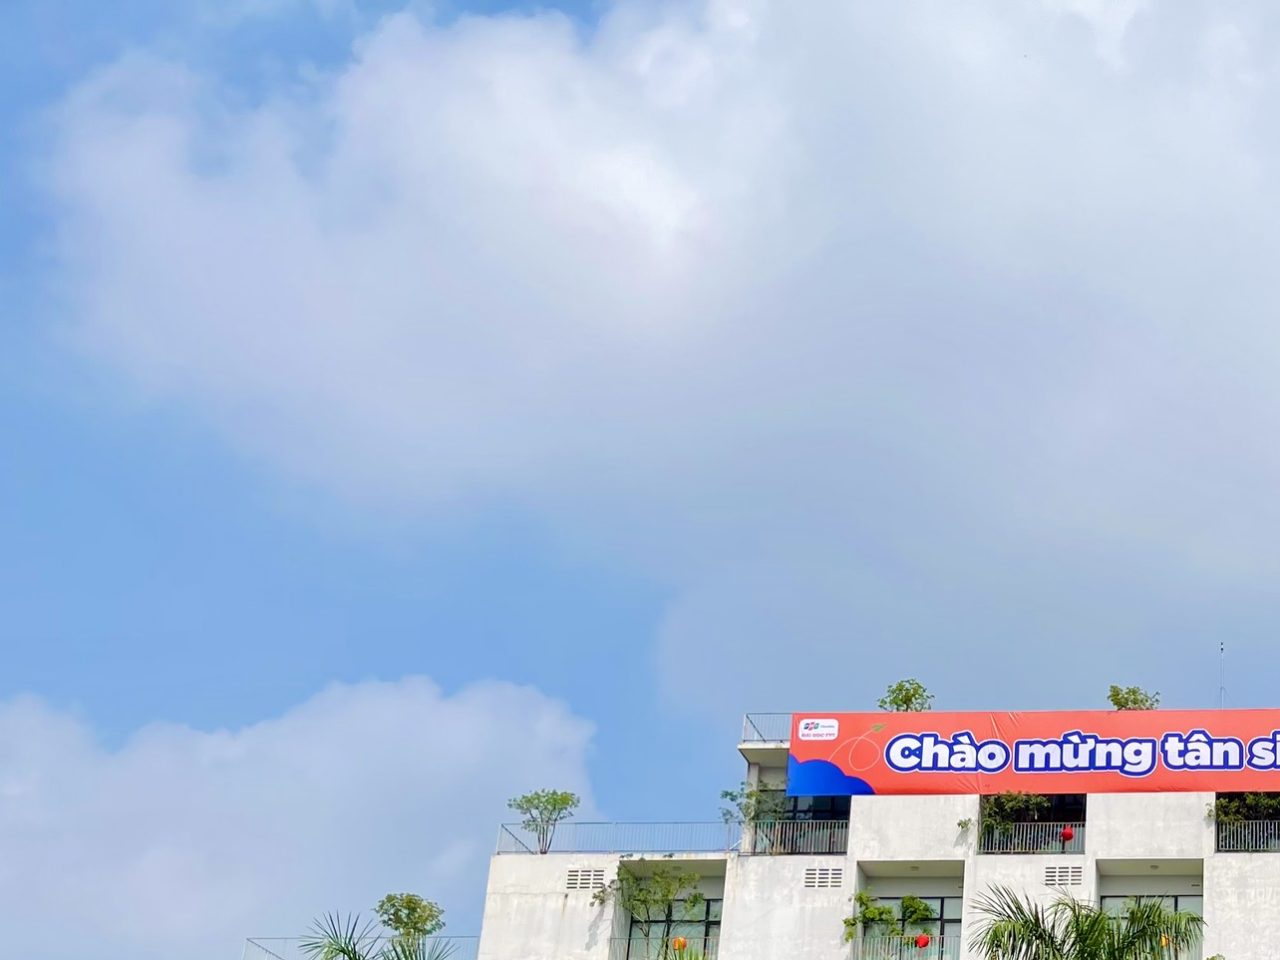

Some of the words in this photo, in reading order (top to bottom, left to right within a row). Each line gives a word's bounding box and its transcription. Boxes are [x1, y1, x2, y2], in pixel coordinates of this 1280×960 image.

[886, 732, 1009, 772] Chào
[1016, 733, 1156, 776] mừng
[1161, 731, 1243, 769] tân
